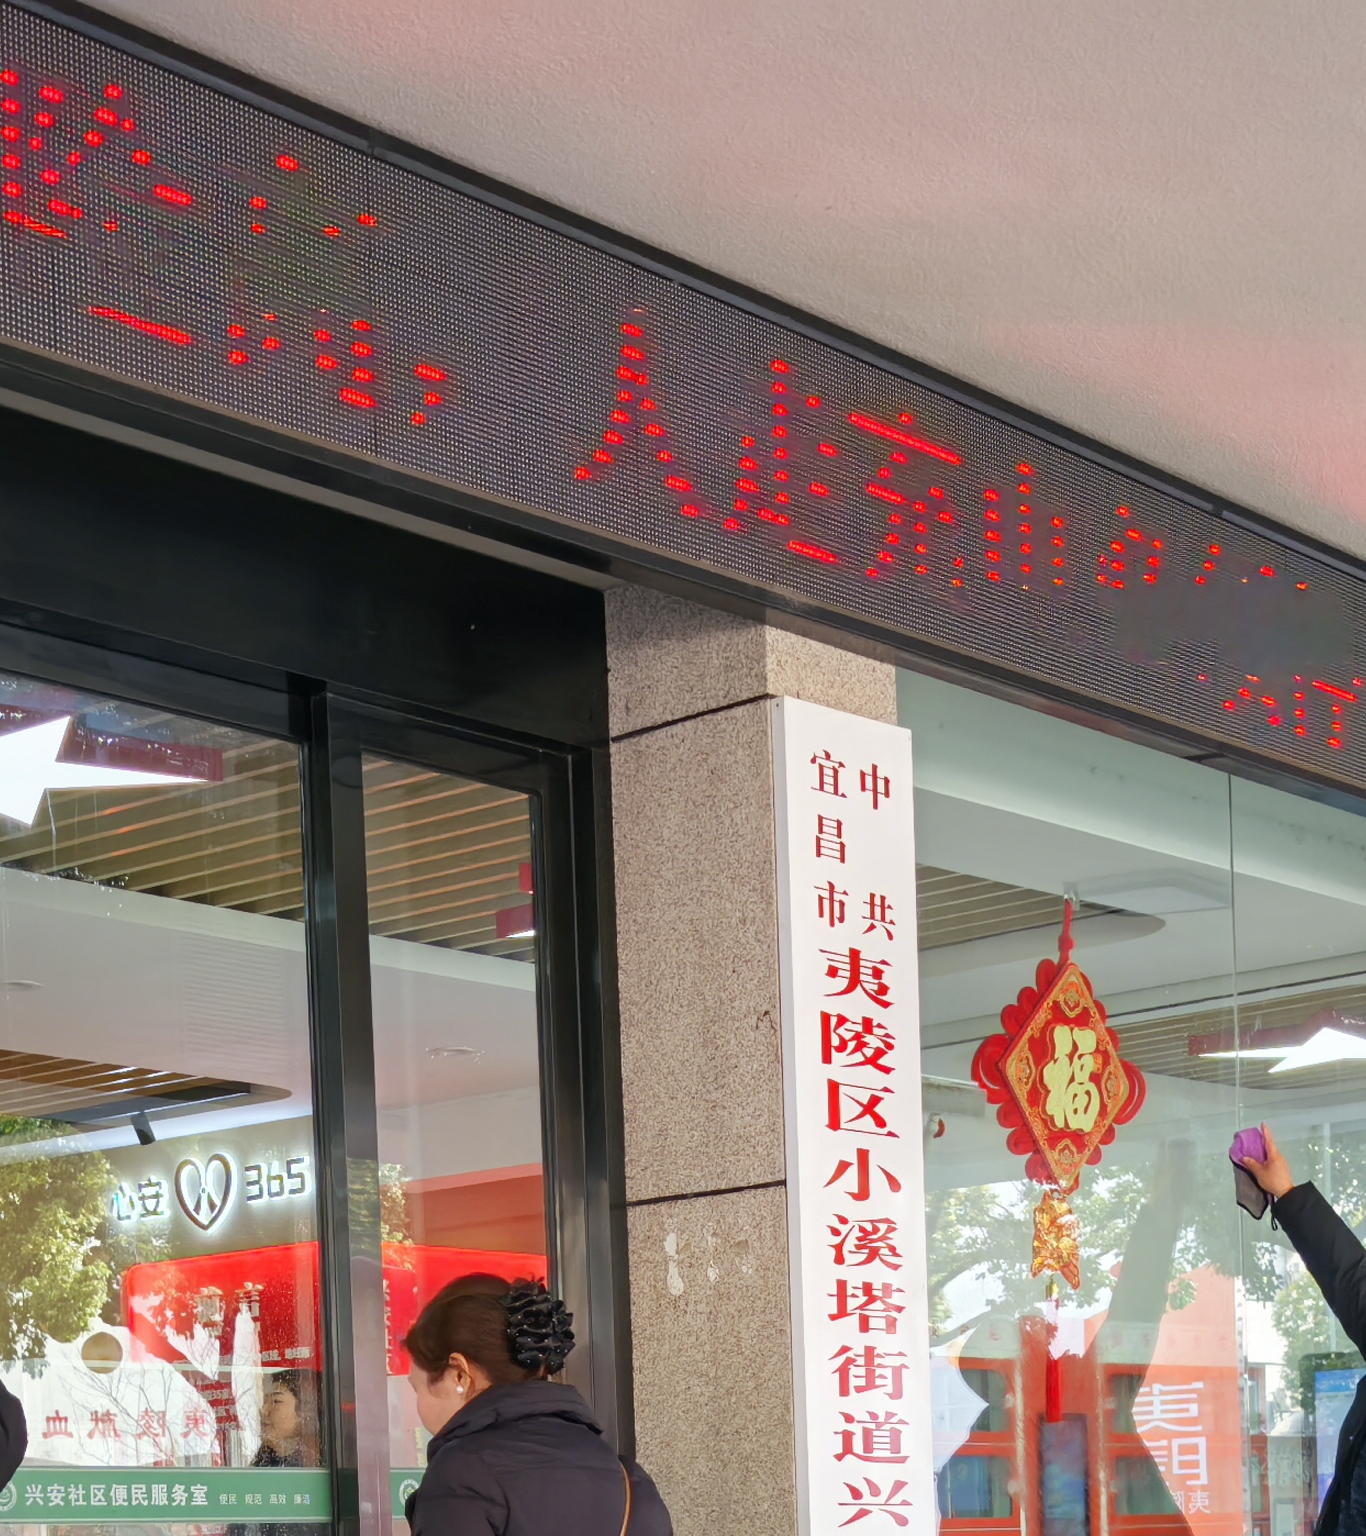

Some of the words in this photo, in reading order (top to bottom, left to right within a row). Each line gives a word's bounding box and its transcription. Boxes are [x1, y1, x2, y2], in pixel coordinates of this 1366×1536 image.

[810, 749, 847, 928] 宜昌市
[860, 763, 896, 941] 中共
[1043, 1025, 1100, 1132] 福
[244, 1156, 313, 1203] 365
[24, 1483, 208, 1507] 兴安社区便民服务室
[219, 1493, 237, 1505] 便民
[245, 1493, 262, 1505] 规范
[269, 1493, 286, 1505] 高效
